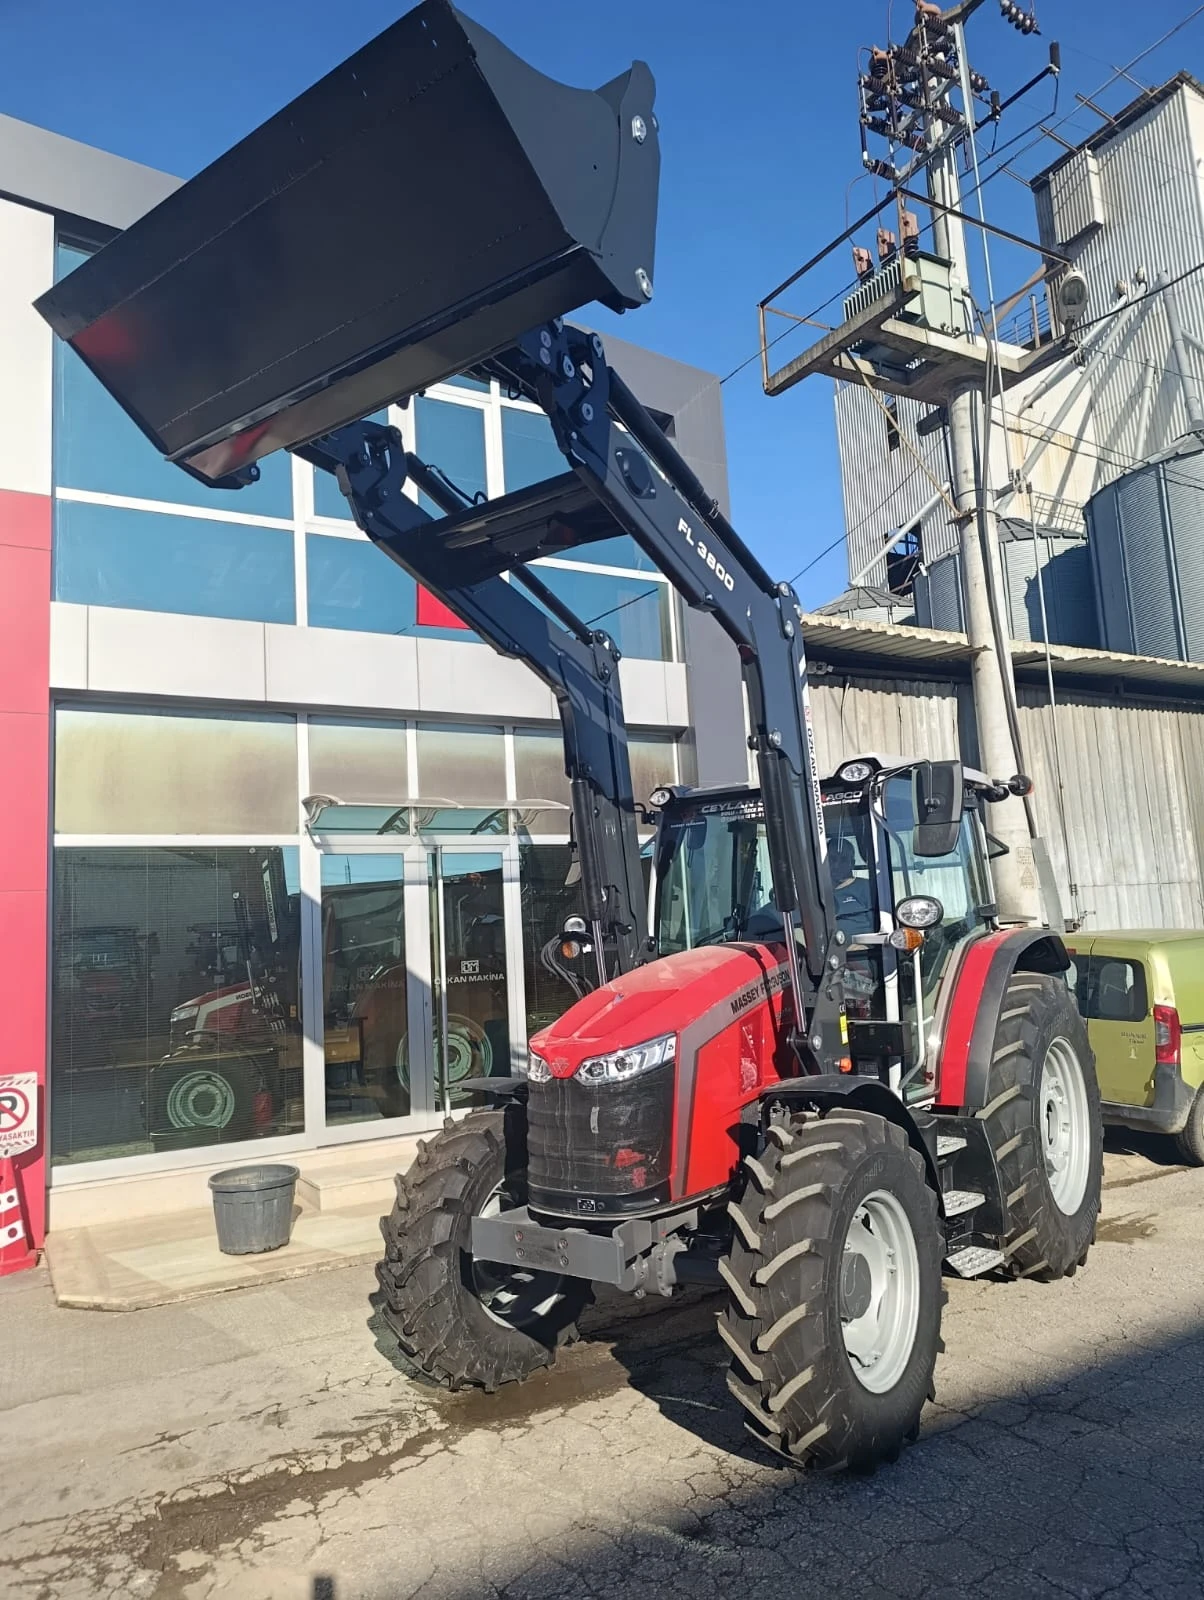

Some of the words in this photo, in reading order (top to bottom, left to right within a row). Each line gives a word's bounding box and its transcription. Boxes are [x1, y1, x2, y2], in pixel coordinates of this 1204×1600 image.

[678, 517, 695, 547] FL
[697, 541, 735, 592] 3800
[826, 790, 863, 802] AGCO
[730, 986, 760, 1014] MASSEY
